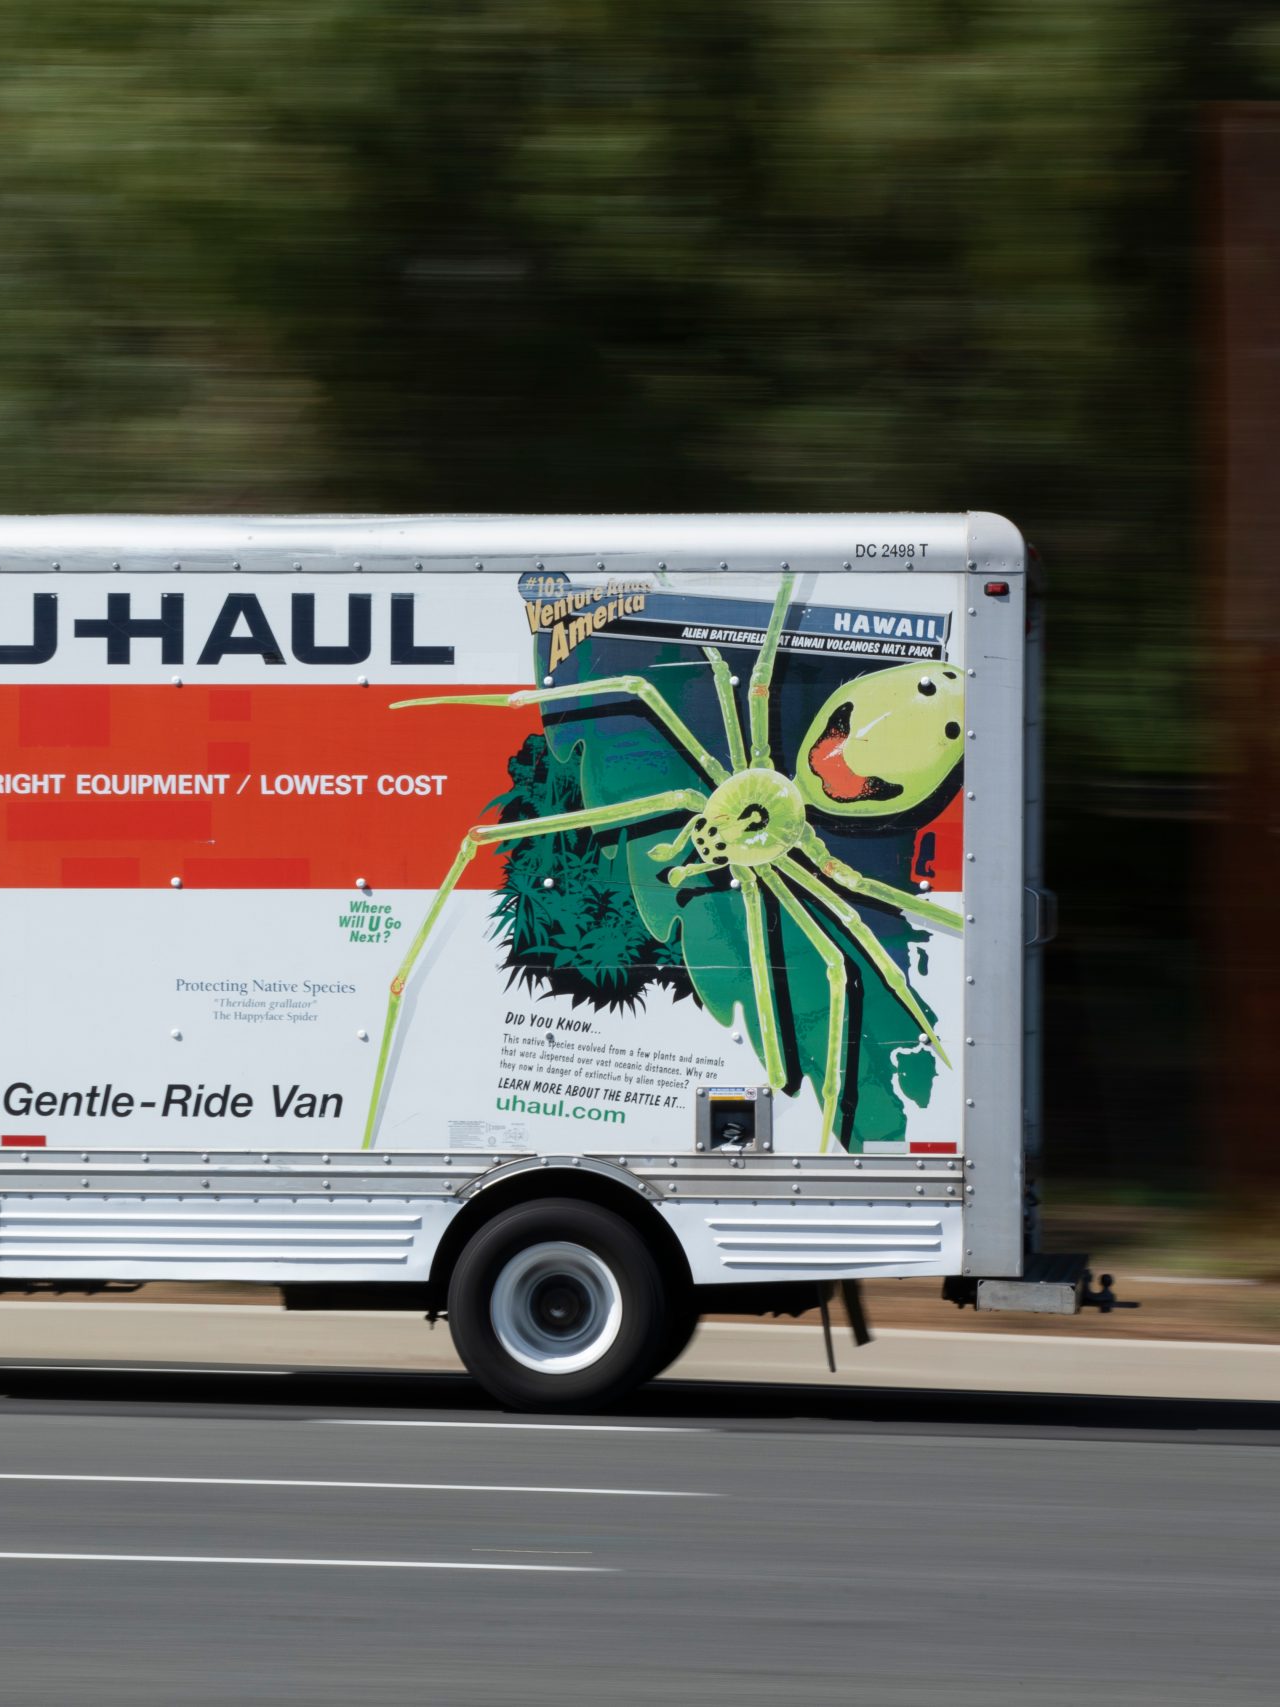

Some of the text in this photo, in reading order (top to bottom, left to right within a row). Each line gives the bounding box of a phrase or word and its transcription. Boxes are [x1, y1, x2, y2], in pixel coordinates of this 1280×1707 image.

[855, 543, 929, 558] DC 2498 T
[525, 576, 565, 598] #103
[525, 584, 604, 634] Venture
[548, 593, 645, 673] America
[833, 612, 937, 639] HAWAII
[681, 627, 709, 639] ALIEN
[777, 635, 791, 646] AT
[791, 636, 825, 648] HAWAII
[826, 639, 880, 654] VOLCANOES
[881, 643, 906, 656] NAT'L
[907, 645, 935, 658] PARK
[76, 773, 231, 796] EQUIPMENT
[260, 774, 369, 796] LOWEST
[377, 774, 449, 796] COST
[349, 900, 392, 914] Where
[338, 915, 402, 932] Will U Go
[175, 978, 356, 997] Protecting Native Species
[213, 1010, 318, 1023] The Happyface Spider
[500, 1046, 718, 1080] that were dispersed over vast oceanic distances. Why are
[503, 1033, 520, 1044] This
[522, 1037, 546, 1047] native
[548, 1039, 575, 1050] species
[577, 1042, 607, 1054] evolved
[608, 1044, 627, 1056] from
[637, 1048, 651, 1059] few
[653, 1050, 676, 1062] plants
[679, 1053, 693, 1064] and
[695, 1056, 725, 1068] animals
[500, 1059, 690, 1089] they now in danger of extinction by alien species?
[272, 1084, 344, 1118] Van
[498, 1077, 532, 1092] LEARN
[533, 1081, 563, 1095] MORE
[565, 1085, 601, 1099] ABOUT
[603, 1088, 622, 1102] THE
[624, 1091, 662, 1106] BATTLE
[496, 1094, 626, 1124] uhaul.com
